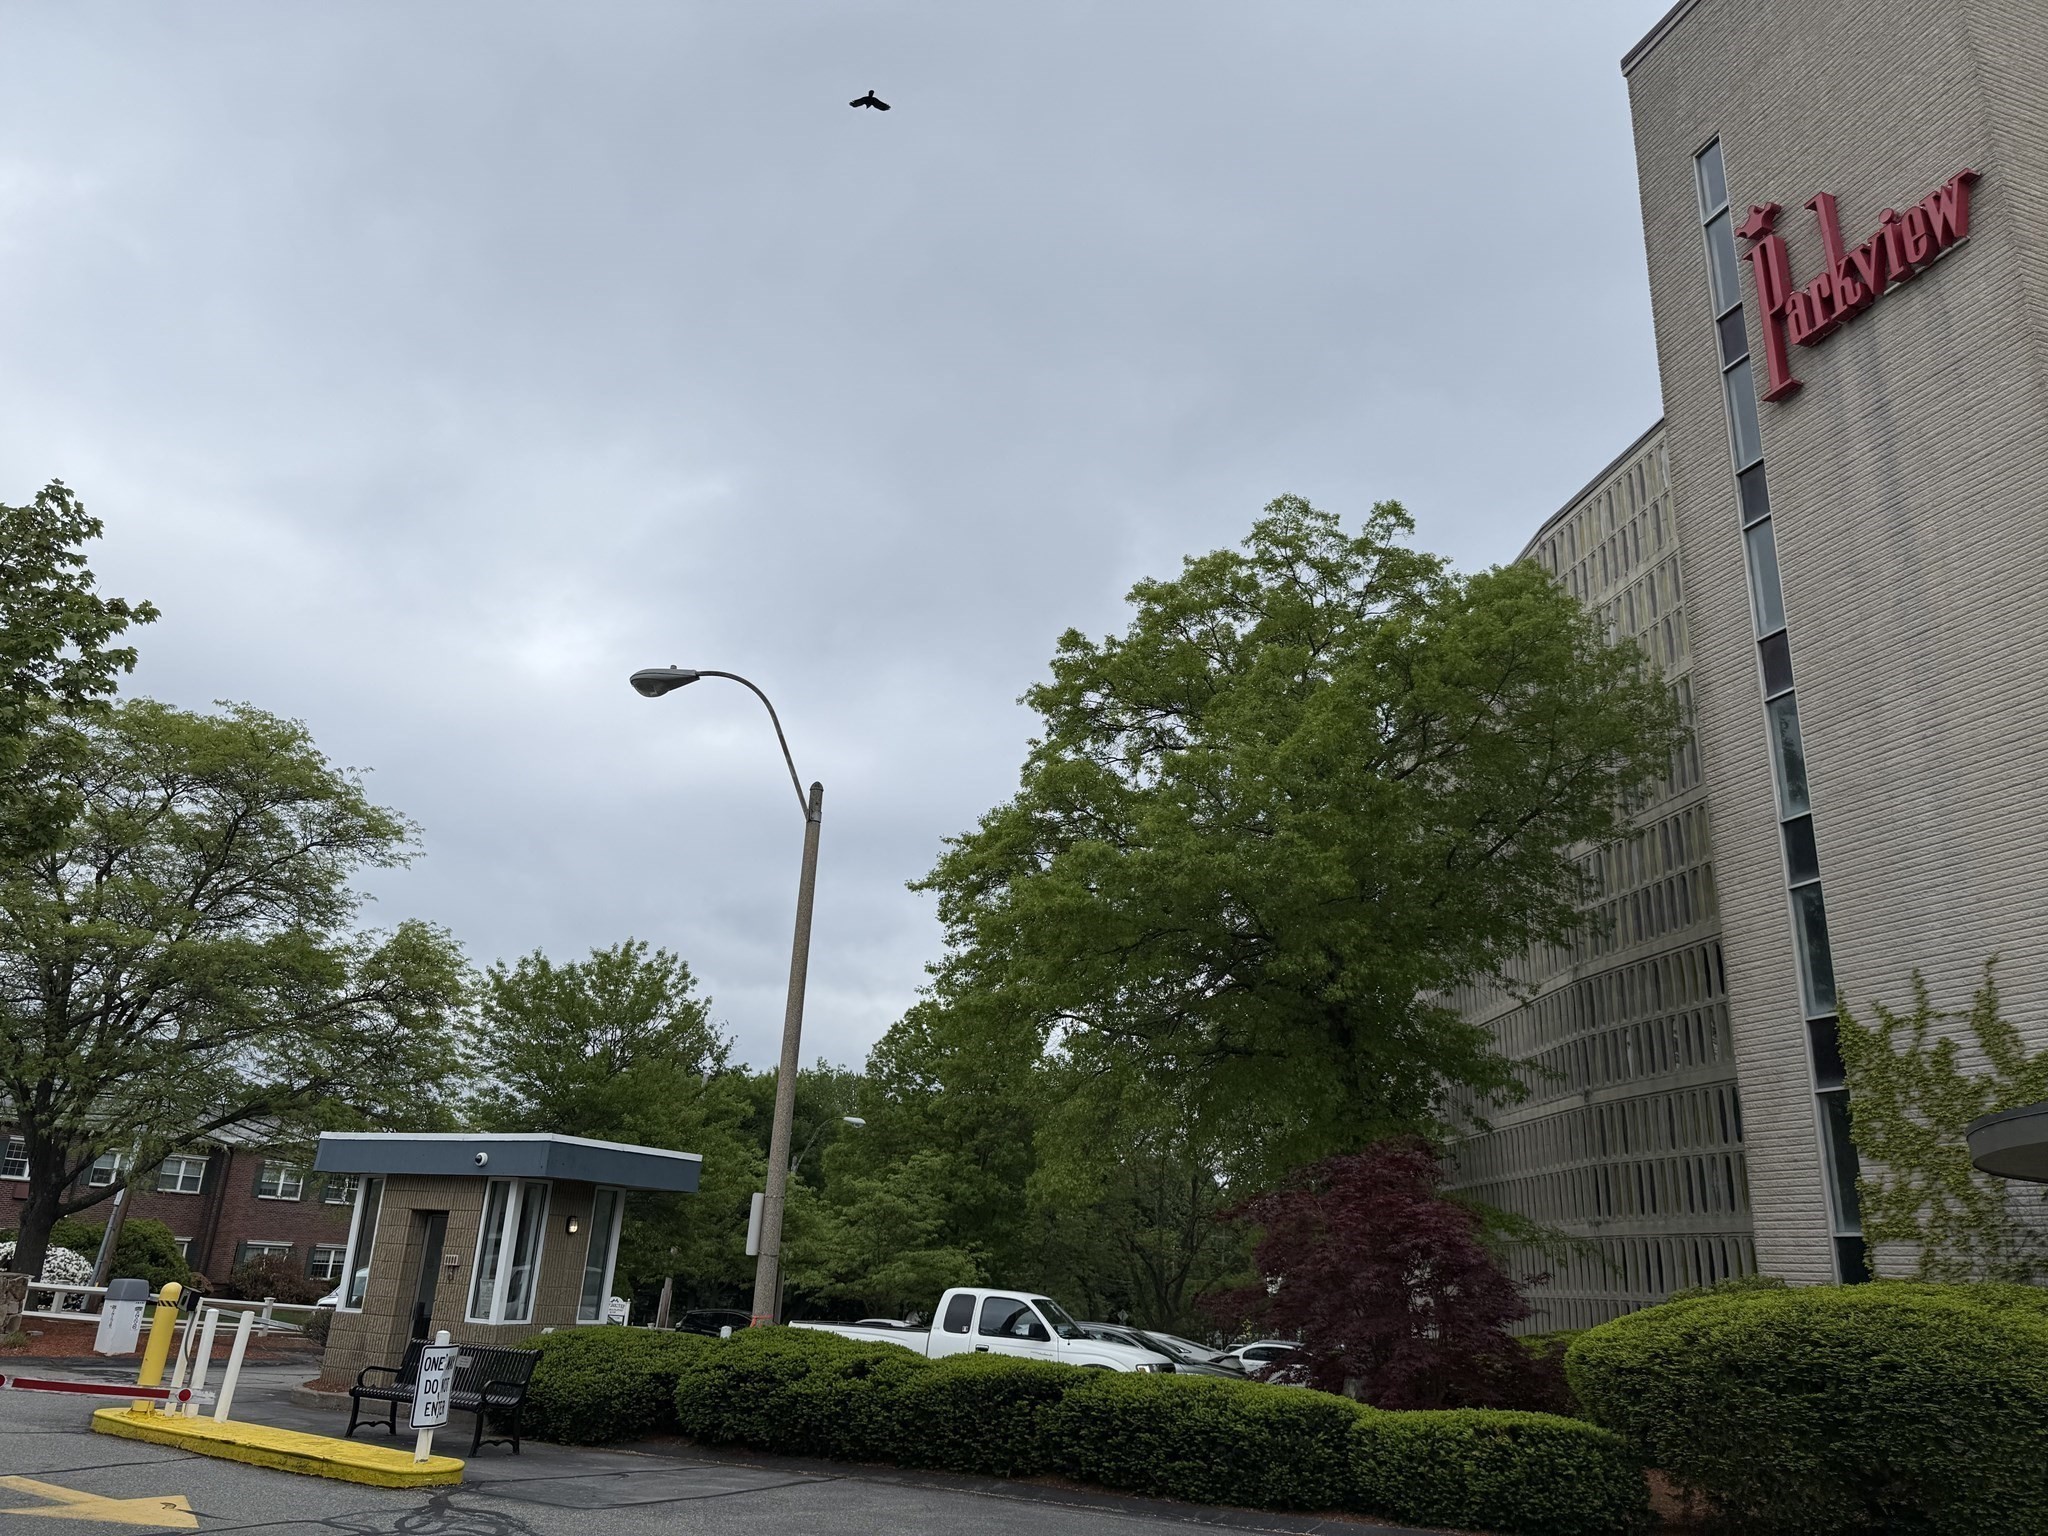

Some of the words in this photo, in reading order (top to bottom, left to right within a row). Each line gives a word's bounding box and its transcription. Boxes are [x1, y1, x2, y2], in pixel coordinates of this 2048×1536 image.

[1740, 167, 1983, 403] Parkview
[424, 1356, 446, 1372] ONE
[424, 1379, 439, 1395] DO
